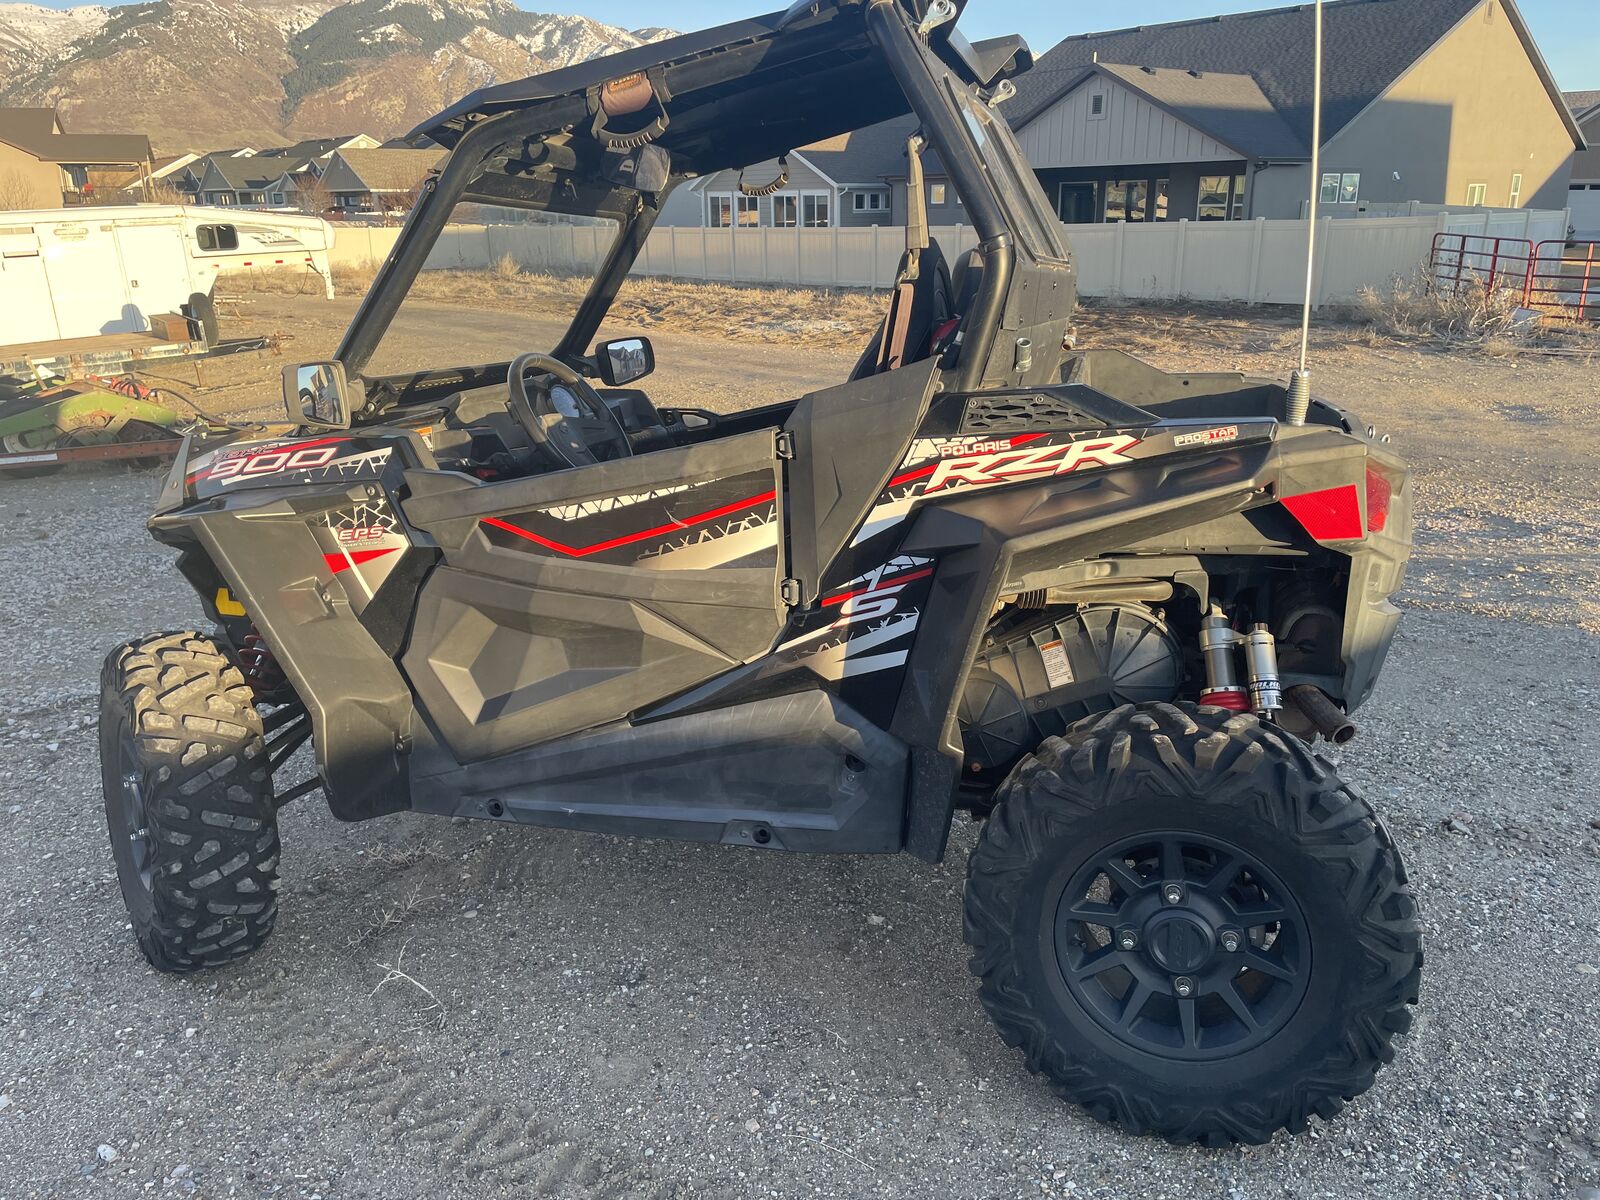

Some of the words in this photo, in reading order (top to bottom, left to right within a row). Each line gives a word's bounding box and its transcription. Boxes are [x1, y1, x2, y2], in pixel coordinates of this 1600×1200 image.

[941, 440, 1011, 457] POLARIS
[1175, 426, 1237, 445] PROSTAR
[207, 447, 337, 480] 900
[924, 434, 1143, 494] RZR
[338, 526, 384, 541] EPS
[831, 583, 908, 630] S
